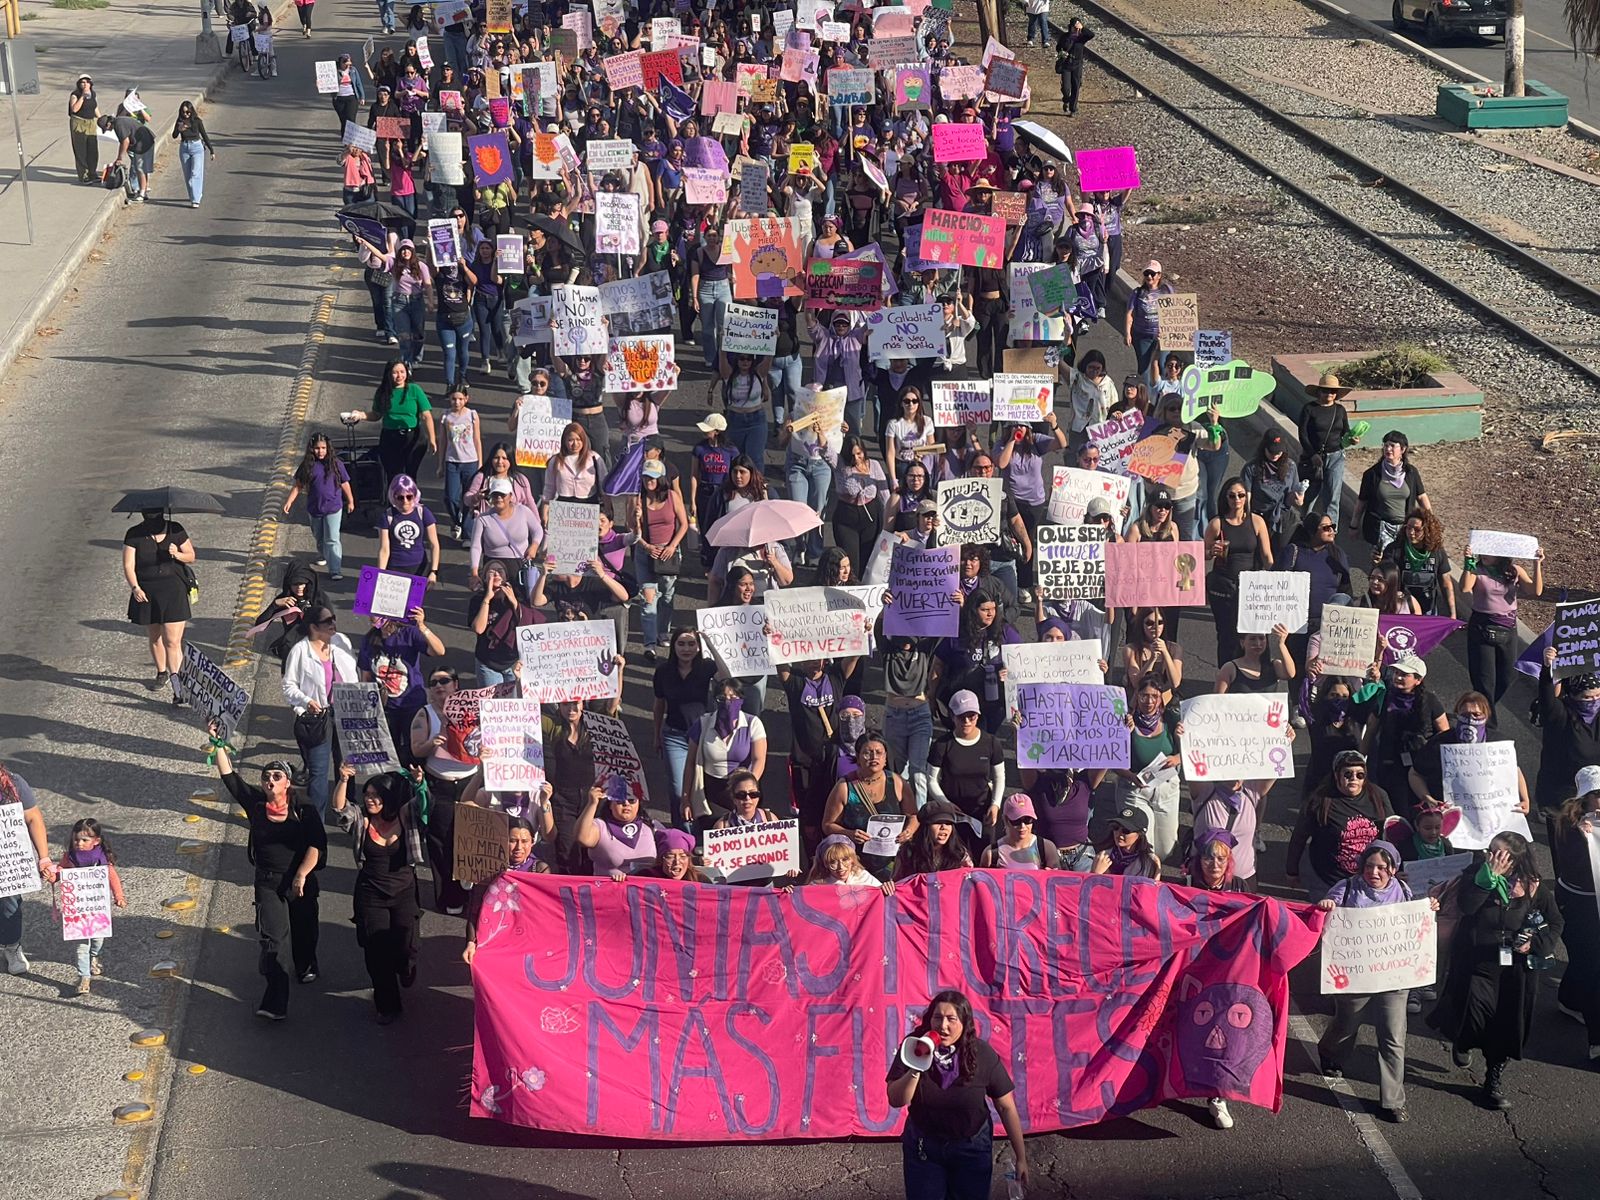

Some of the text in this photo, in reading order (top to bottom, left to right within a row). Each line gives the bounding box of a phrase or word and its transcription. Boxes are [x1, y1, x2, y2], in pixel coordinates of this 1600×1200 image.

[931, 212, 982, 231] MARCHO
[808, 274, 844, 290] CREZCAN
[1158, 297, 1173, 309] POR
[565, 304, 586, 317] NO
[727, 303, 776, 320] La maestra
[887, 310, 933, 324] Calladita
[555, 317, 596, 329] SE RINDE
[897, 323, 919, 334] NO
[1169, 332, 1187, 340] PARA
[1199, 332, 1213, 340] Por
[614, 340, 666, 352] YO PROTESTO
[906, 341, 935, 350] bonita
[1199, 339, 1226, 348] mundo
[961, 382, 965, 390] A
[967, 382, 976, 390] MI
[943, 391, 988, 403] LIBERTAD
[945, 402, 969, 411] LLAMA
[938, 410, 991, 425] MACHISMO
[1008, 410, 1040, 420] MUJERES
[524, 438, 561, 449] NOSOTR
[941, 481, 990, 505] MUJER
[554, 503, 596, 520] QUISIERON
[1039, 526, 1105, 543] QUE SER
[1040, 544, 1099, 560] MUJER
[1039, 560, 1105, 575] DEJE DE
[1405, 562, 1434, 571] BLIN
[1044, 574, 1105, 586] SER UNA
[1248, 580, 1289, 593] Aunque NO
[888, 590, 954, 610] MUERTA
[1042, 586, 1105, 600] CONDENA
[771, 600, 815, 616] PACIENTE
[1245, 602, 1298, 612] sabemos lo que
[1562, 603, 1600, 620] MARC
[773, 613, 834, 629] ENCONTRADA
[520, 626, 591, 642] Que los ojos de
[815, 623, 850, 636] VITALES
[1556, 625, 1587, 638] QUE
[521, 636, 607, 652] las DESAPARECIDAS
[781, 637, 847, 657] OTRA VEZ
[538, 651, 571, 666] persigan
[573, 650, 584, 658] en
[723, 646, 760, 659] SU VOZ
[187, 641, 235, 694] TE PREFIERO
[527, 662, 553, 673] sueños
[561, 660, 570, 669] el
[572, 658, 593, 667] llanto
[1552, 655, 1585, 669] FALTE
[535, 670, 545, 680] de
[561, 667, 594, 677] MADRES
[183, 656, 224, 700] VIOLENTA
[222, 697, 244, 721] QUE
[555, 677, 573, 688] dejen
[449, 688, 496, 699] MARCHO
[1018, 687, 1109, 711] ¡HASTA QUE
[447, 699, 479, 707] TODAS
[524, 699, 539, 711] VER
[489, 715, 504, 723] MIS
[505, 714, 540, 725] AMIGAS
[1020, 710, 1087, 729] DEJEN DE
[1188, 702, 1260, 732] Soy madre
[586, 723, 597, 731] LA
[588, 730, 629, 748] PERO ELLA
[1040, 727, 1123, 743] DEJAMOS DE
[591, 741, 631, 758] FUE UNA
[1037, 740, 1129, 764] MARCHAR!
[593, 752, 635, 769] VICTIMA
[486, 763, 546, 781] PRESIDENTA
[607, 765, 635, 778] MAS
[10, 818, 23, 827] las
[459, 807, 494, 825] QUIEN
[474, 824, 495, 838] AMA
[747, 825, 756, 833] DE
[458, 836, 505, 858] NO MATA
[708, 832, 788, 856] YO DOY LA CARA
[457, 857, 507, 872] HUMILLA
[730, 857, 743, 869] SE
[746, 849, 789, 864] ESCONDE
[459, 868, 468, 879] O
[523, 881, 852, 1002] JUNTAS
[586, 990, 781, 1136] MÁS
